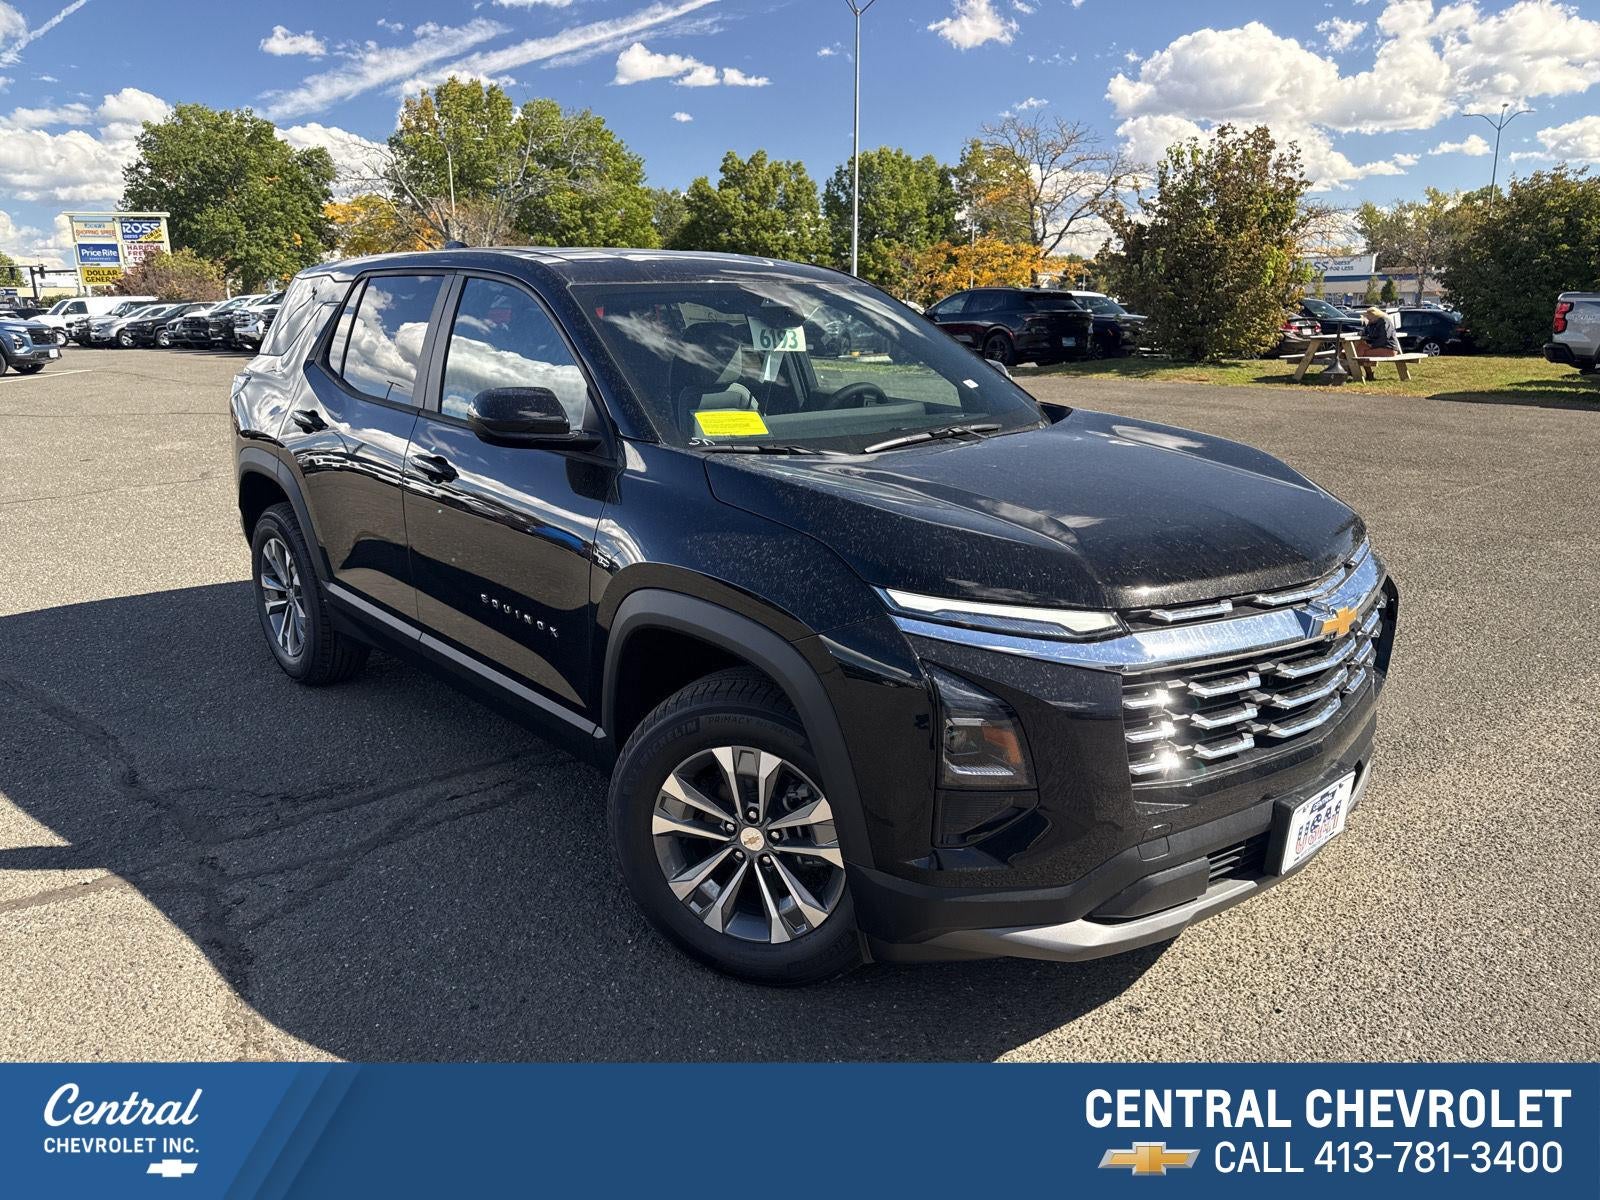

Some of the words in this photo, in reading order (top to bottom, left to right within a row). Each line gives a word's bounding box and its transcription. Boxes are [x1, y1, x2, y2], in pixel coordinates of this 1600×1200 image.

[122, 223, 159, 234] ROSS
[81, 249, 101, 257] Price
[101, 249, 118, 257] Rite
[480, 593, 558, 638] EQUINOX
[707, 714, 753, 725] PRIMACY
